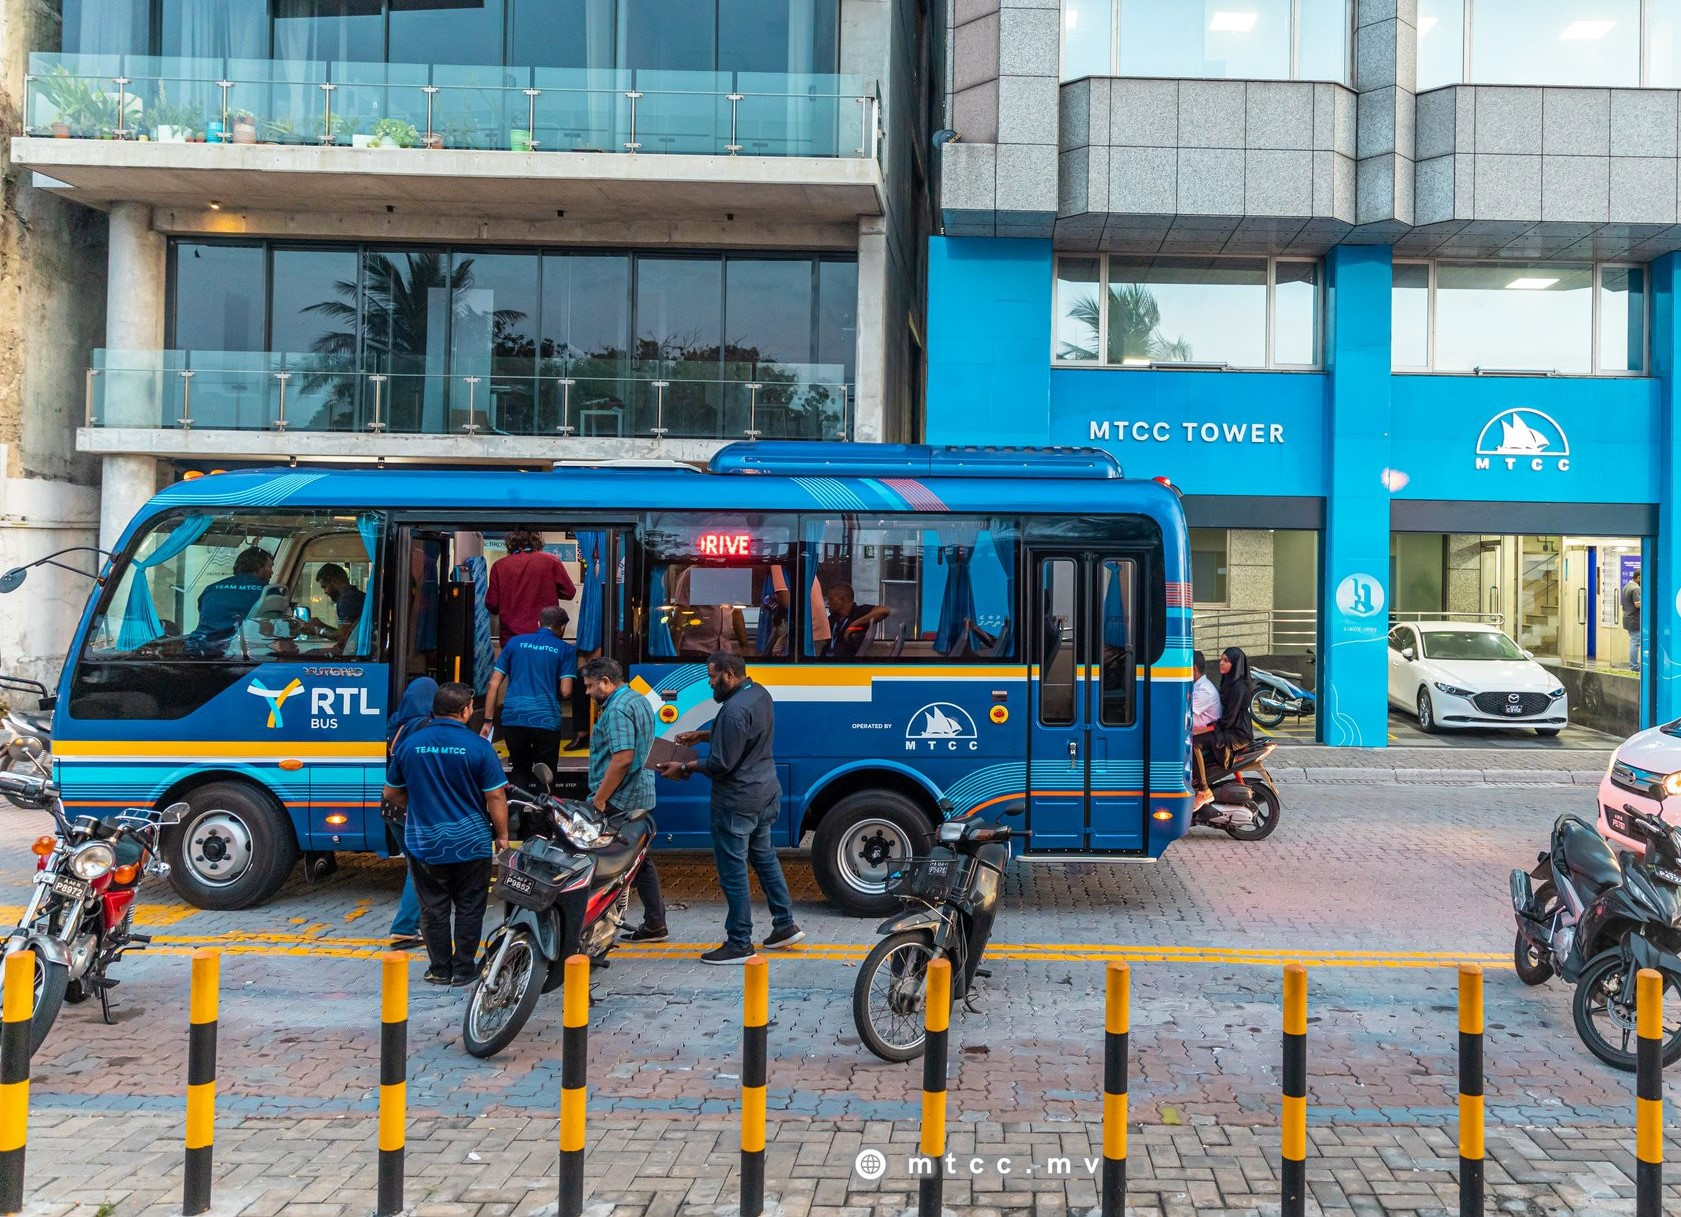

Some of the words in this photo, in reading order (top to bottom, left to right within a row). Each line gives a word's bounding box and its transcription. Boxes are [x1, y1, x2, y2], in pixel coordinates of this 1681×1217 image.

[1089, 420, 1171, 441] MTCC
[1182, 422, 1285, 443] TOWER
[1475, 457, 1570, 471] MTCC
[520, 642, 538, 650] TEAM
[538, 645, 559, 653] MTCC
[311, 687, 380, 715] RTL
[311, 718, 338, 729] BUS
[415, 746, 439, 754] TEAM
[440, 746, 467, 755] MTCC
[905, 740, 978, 750] MTCC
[55, 882, 83, 897] P8972
